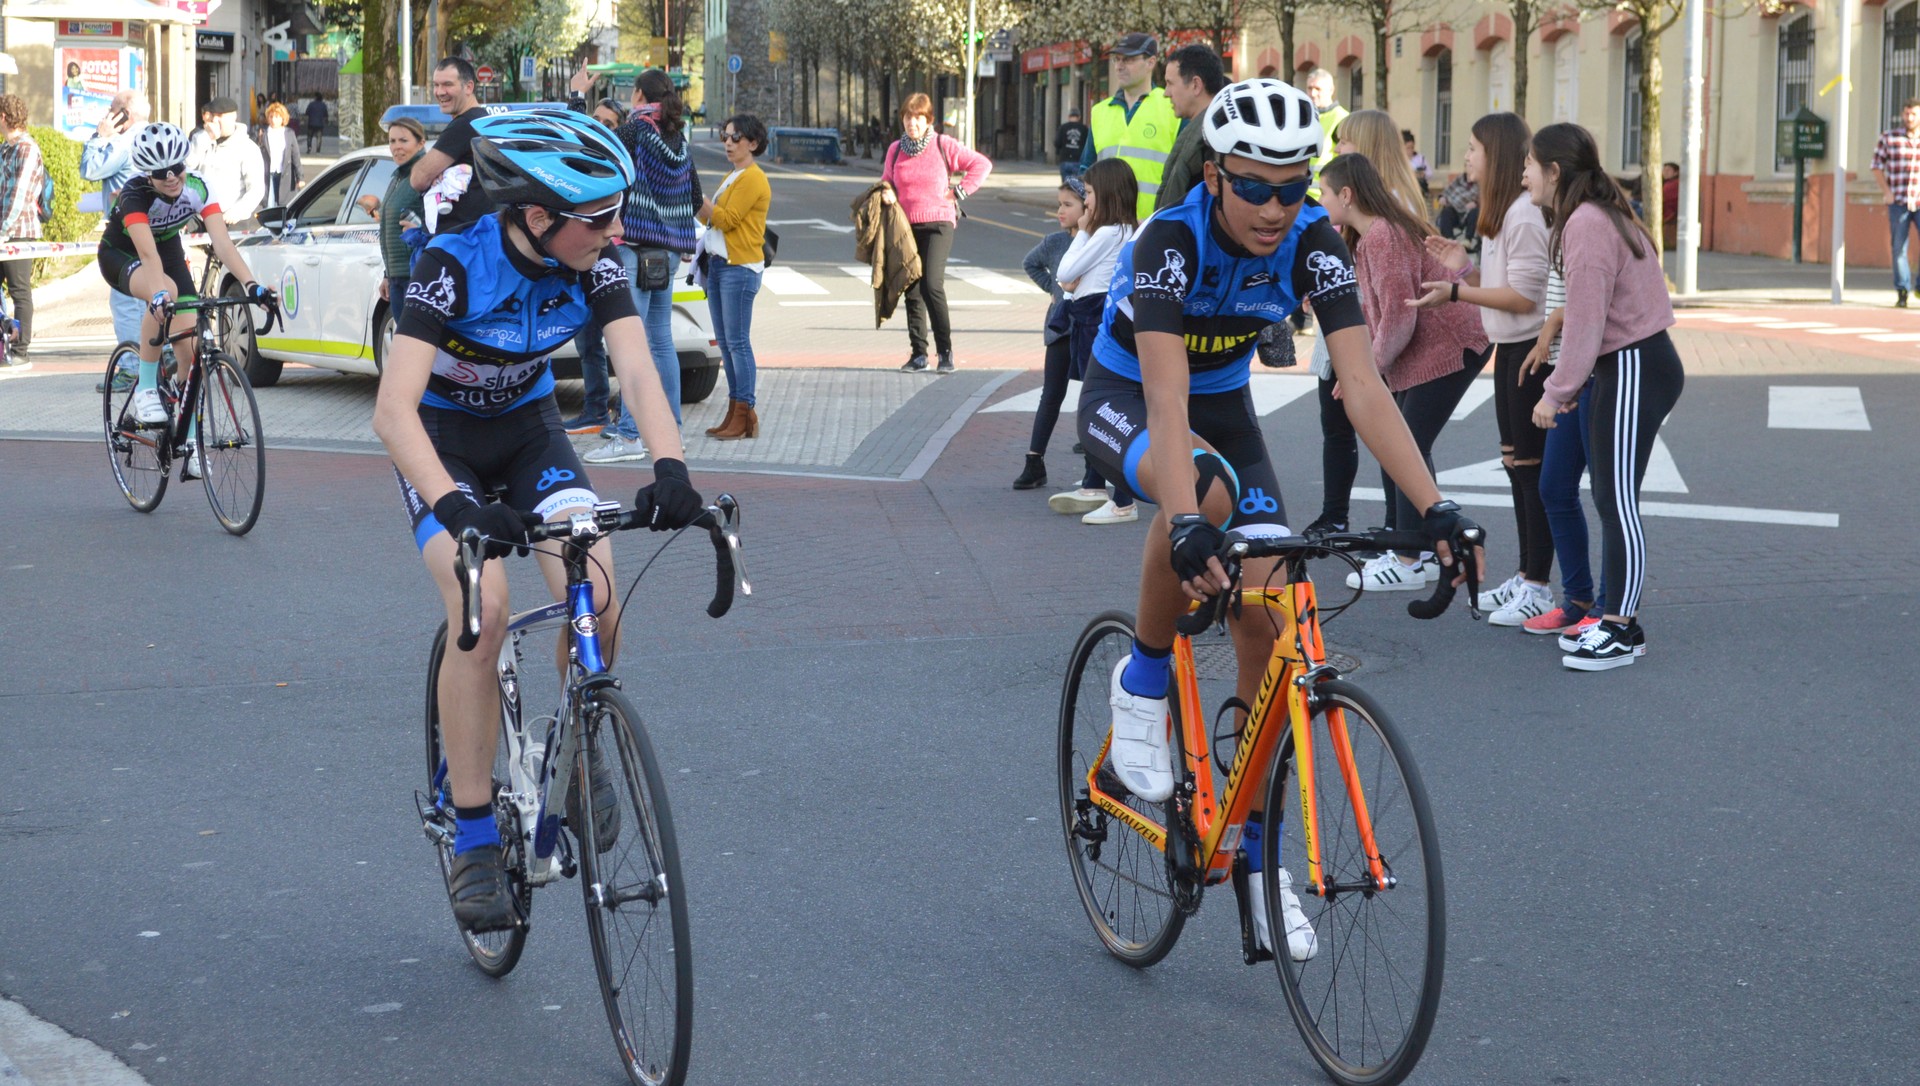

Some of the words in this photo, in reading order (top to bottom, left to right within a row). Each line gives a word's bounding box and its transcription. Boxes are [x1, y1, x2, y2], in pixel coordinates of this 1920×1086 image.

[81, 59, 118, 75] FOTOS
[1234, 301, 1284, 315] FullGas
[1099, 797, 1159, 843] SPECIALIZED
